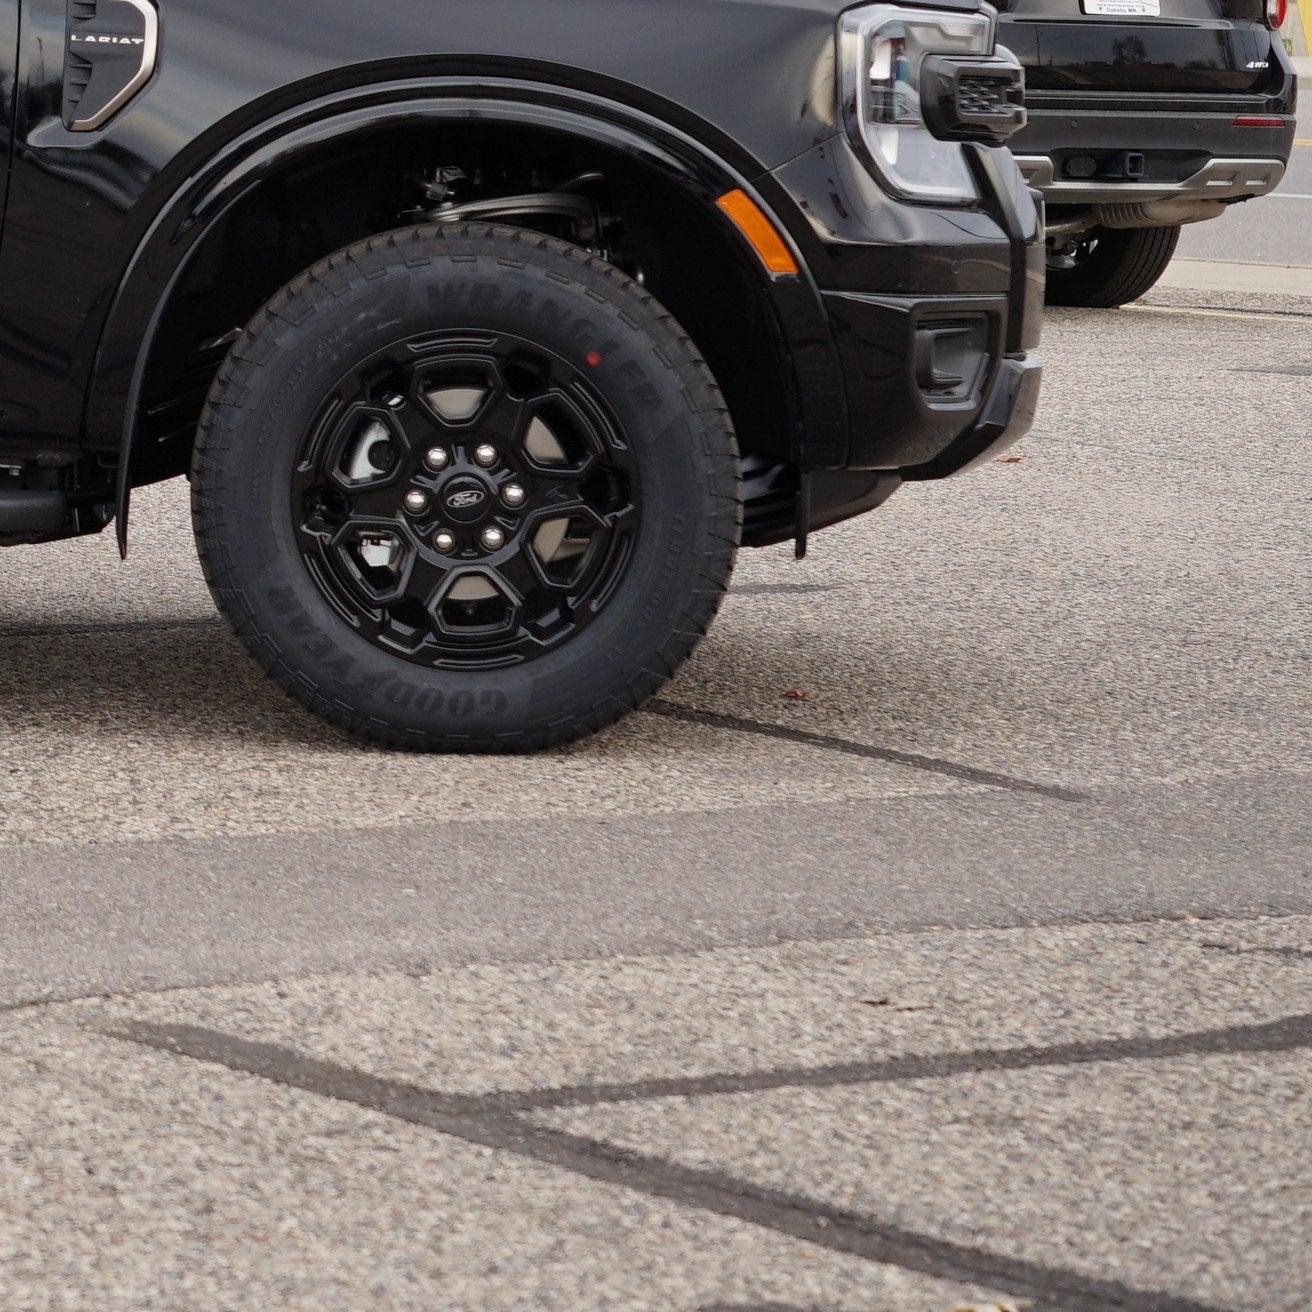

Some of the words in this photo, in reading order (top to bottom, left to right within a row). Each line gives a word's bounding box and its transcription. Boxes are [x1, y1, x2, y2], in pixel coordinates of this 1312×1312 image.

[71, 34, 144, 45] LARIAT
[1246, 61, 1269, 69] 4WD
[426, 280, 666, 412] WRANGLER
[452, 492, 478, 506] Ford
